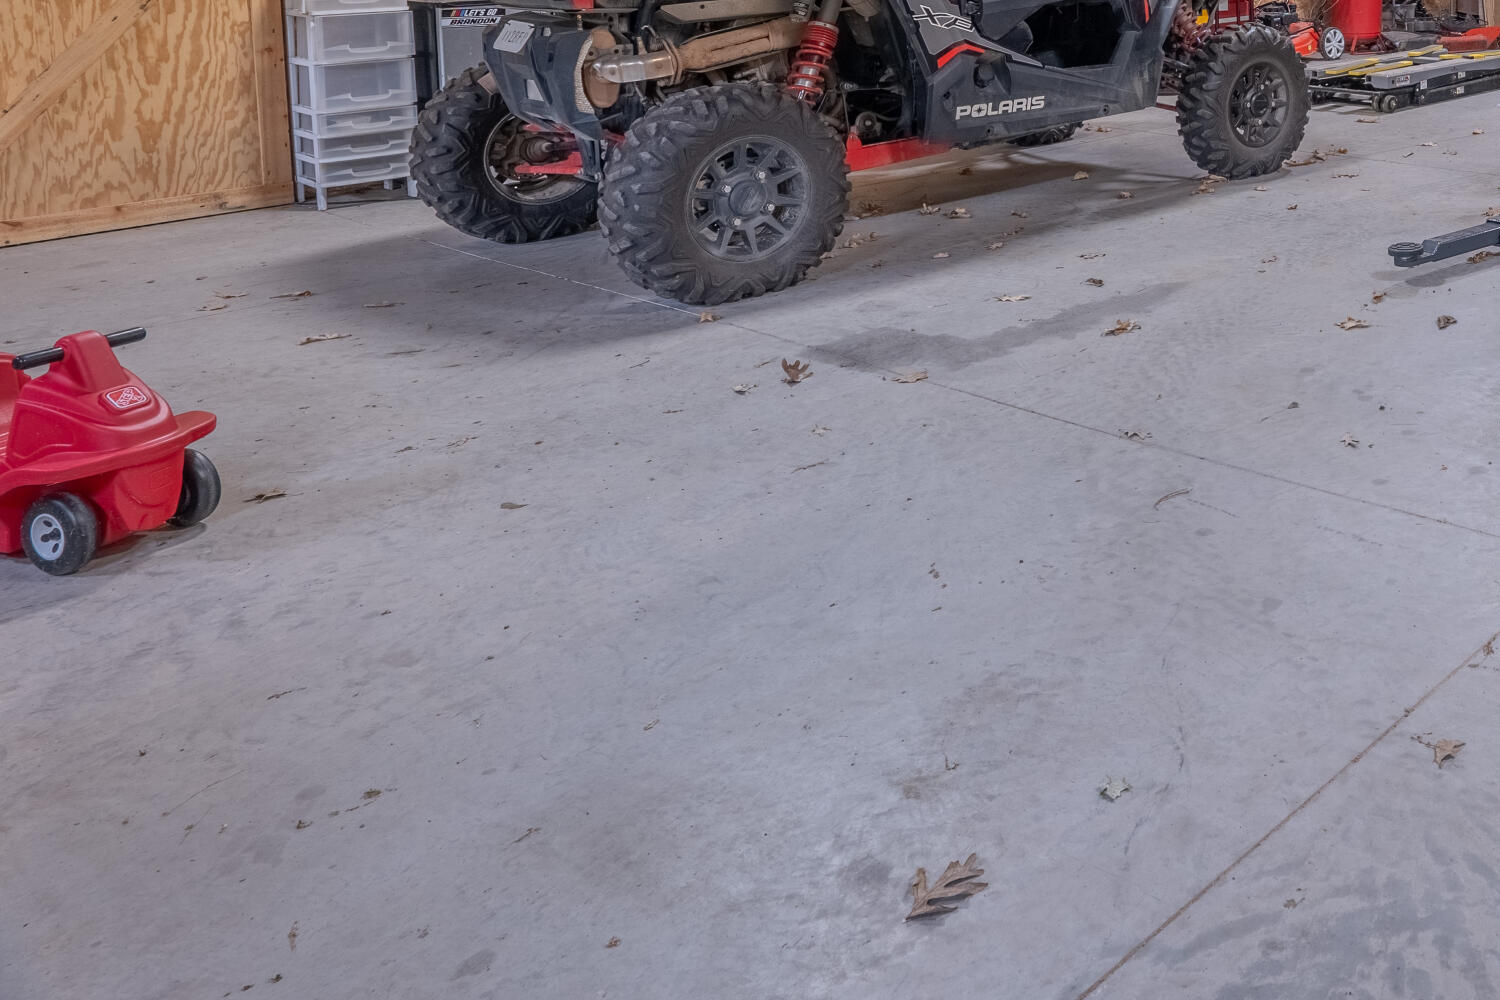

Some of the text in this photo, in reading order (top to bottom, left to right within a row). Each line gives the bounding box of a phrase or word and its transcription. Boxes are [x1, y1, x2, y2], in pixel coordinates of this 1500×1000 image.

[464, 8, 498, 17] LET'S GO
[450, 17, 498, 26] BRANDON
[954, 95, 1047, 120] POLARIS
